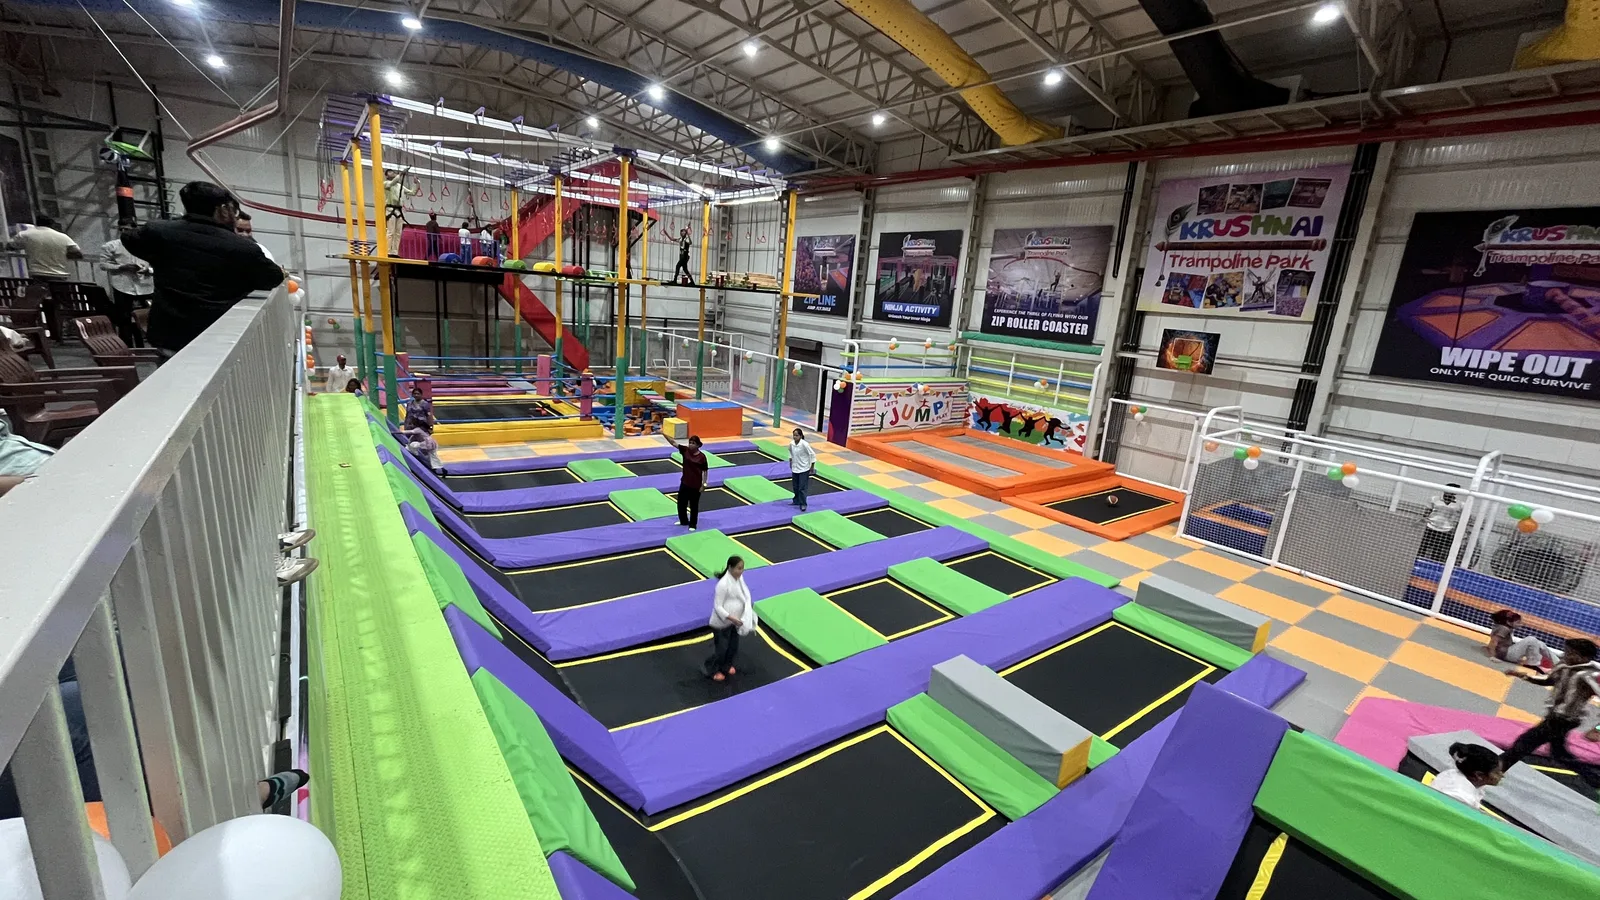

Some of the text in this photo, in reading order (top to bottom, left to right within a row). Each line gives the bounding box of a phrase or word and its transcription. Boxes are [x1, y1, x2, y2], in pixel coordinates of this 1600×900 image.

[1179, 215, 1324, 241] KRUSHNAI
[1169, 253, 1313, 272] Trampoline Park
[1489, 252, 1576, 266] Trampoline
[817, 294, 836, 306] LINE
[884, 303, 938, 315] NINJA ACTIVITY
[991, 315, 1089, 336] ZIP ROLLER COASTER
[1440, 346, 1593, 379] WIPE OUT
[1430, 367, 1592, 391] ONLY THE QUICK SURVIVE
[889, 400, 944, 426] JUMP
